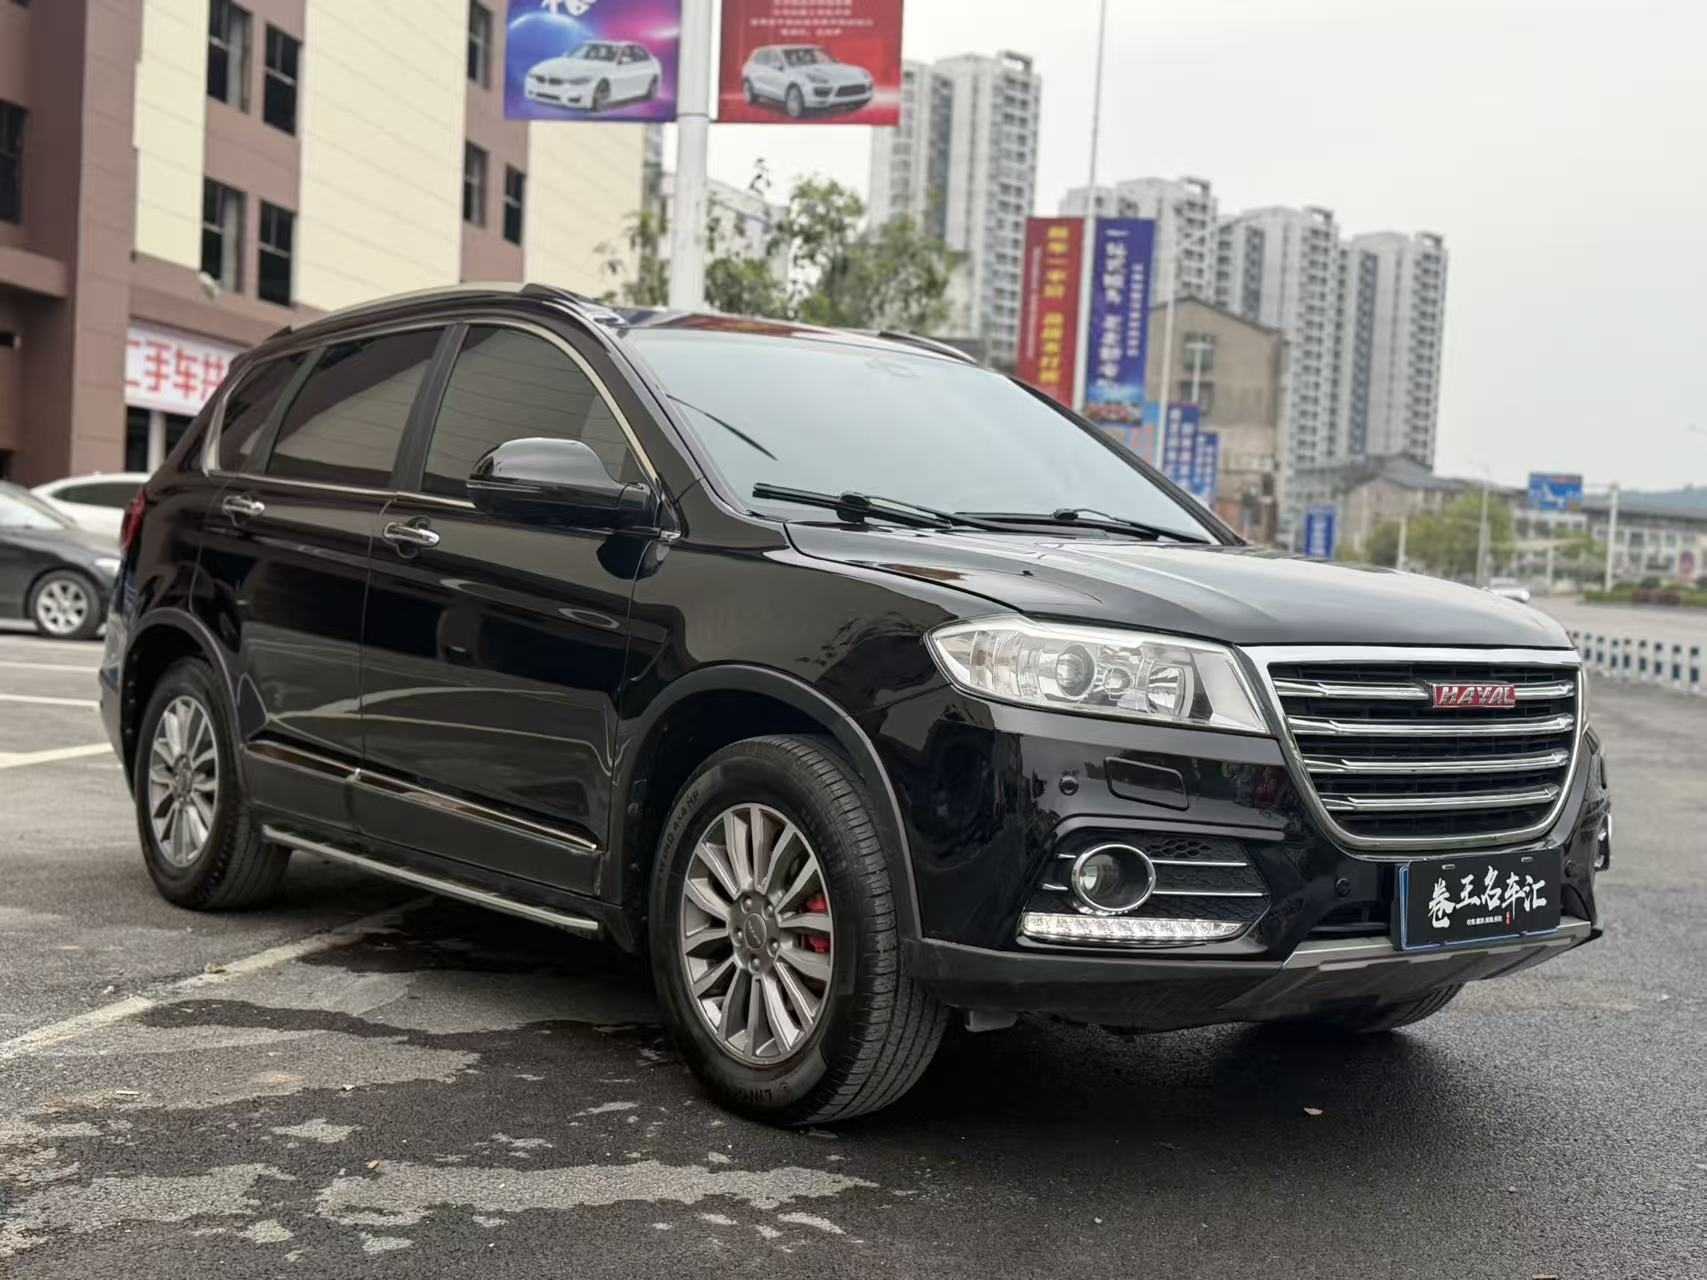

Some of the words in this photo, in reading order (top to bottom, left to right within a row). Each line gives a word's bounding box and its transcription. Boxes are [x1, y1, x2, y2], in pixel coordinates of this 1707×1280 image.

[1439, 686, 1515, 705] HAVAL
[1427, 865, 1547, 928] 卷王名车汇
